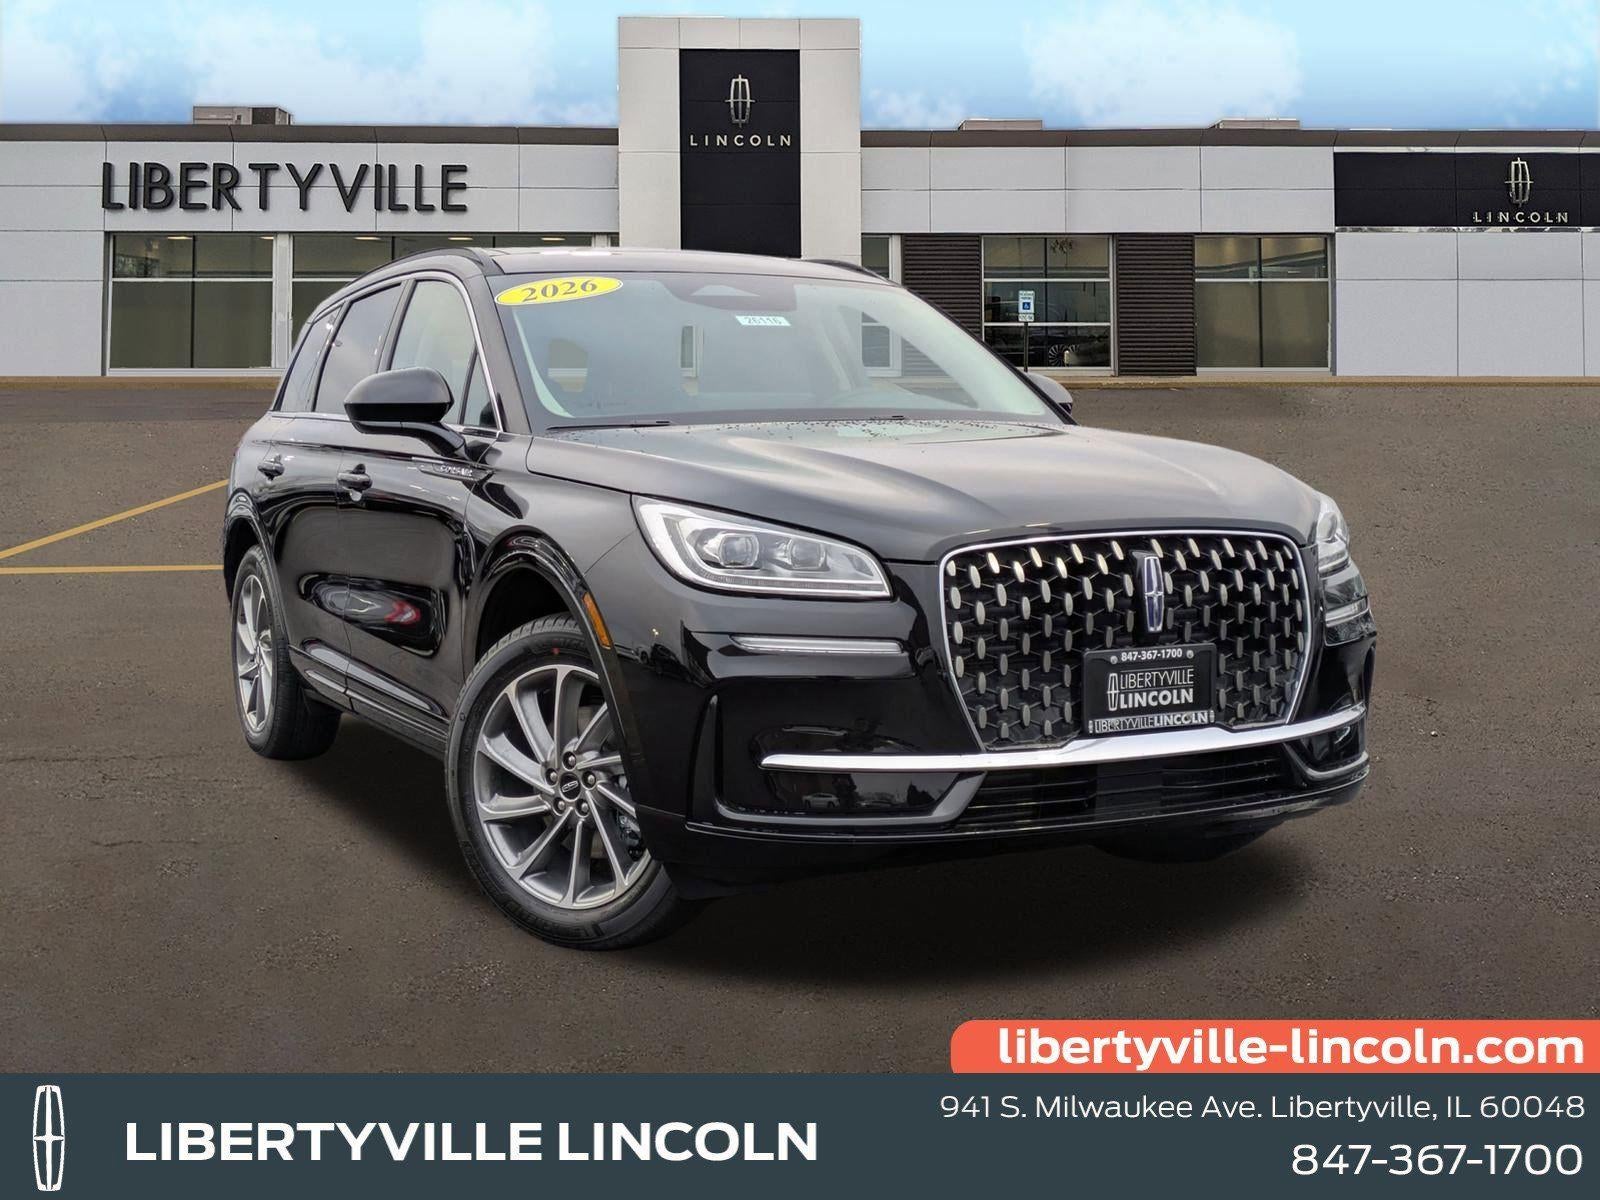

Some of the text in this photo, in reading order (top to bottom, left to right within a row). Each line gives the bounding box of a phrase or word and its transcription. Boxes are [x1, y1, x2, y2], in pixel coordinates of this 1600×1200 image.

[689, 134, 792, 147] LINCOLN
[101, 161, 468, 212] LIBERTYVILLE
[1472, 211, 1568, 223] LINCOLN
[521, 279, 598, 302] 2026
[1121, 648, 1183, 662] 847-367-1700
[1119, 668, 1194, 690] LIBERTYVILLE
[1119, 688, 1194, 709] LINCOLN
